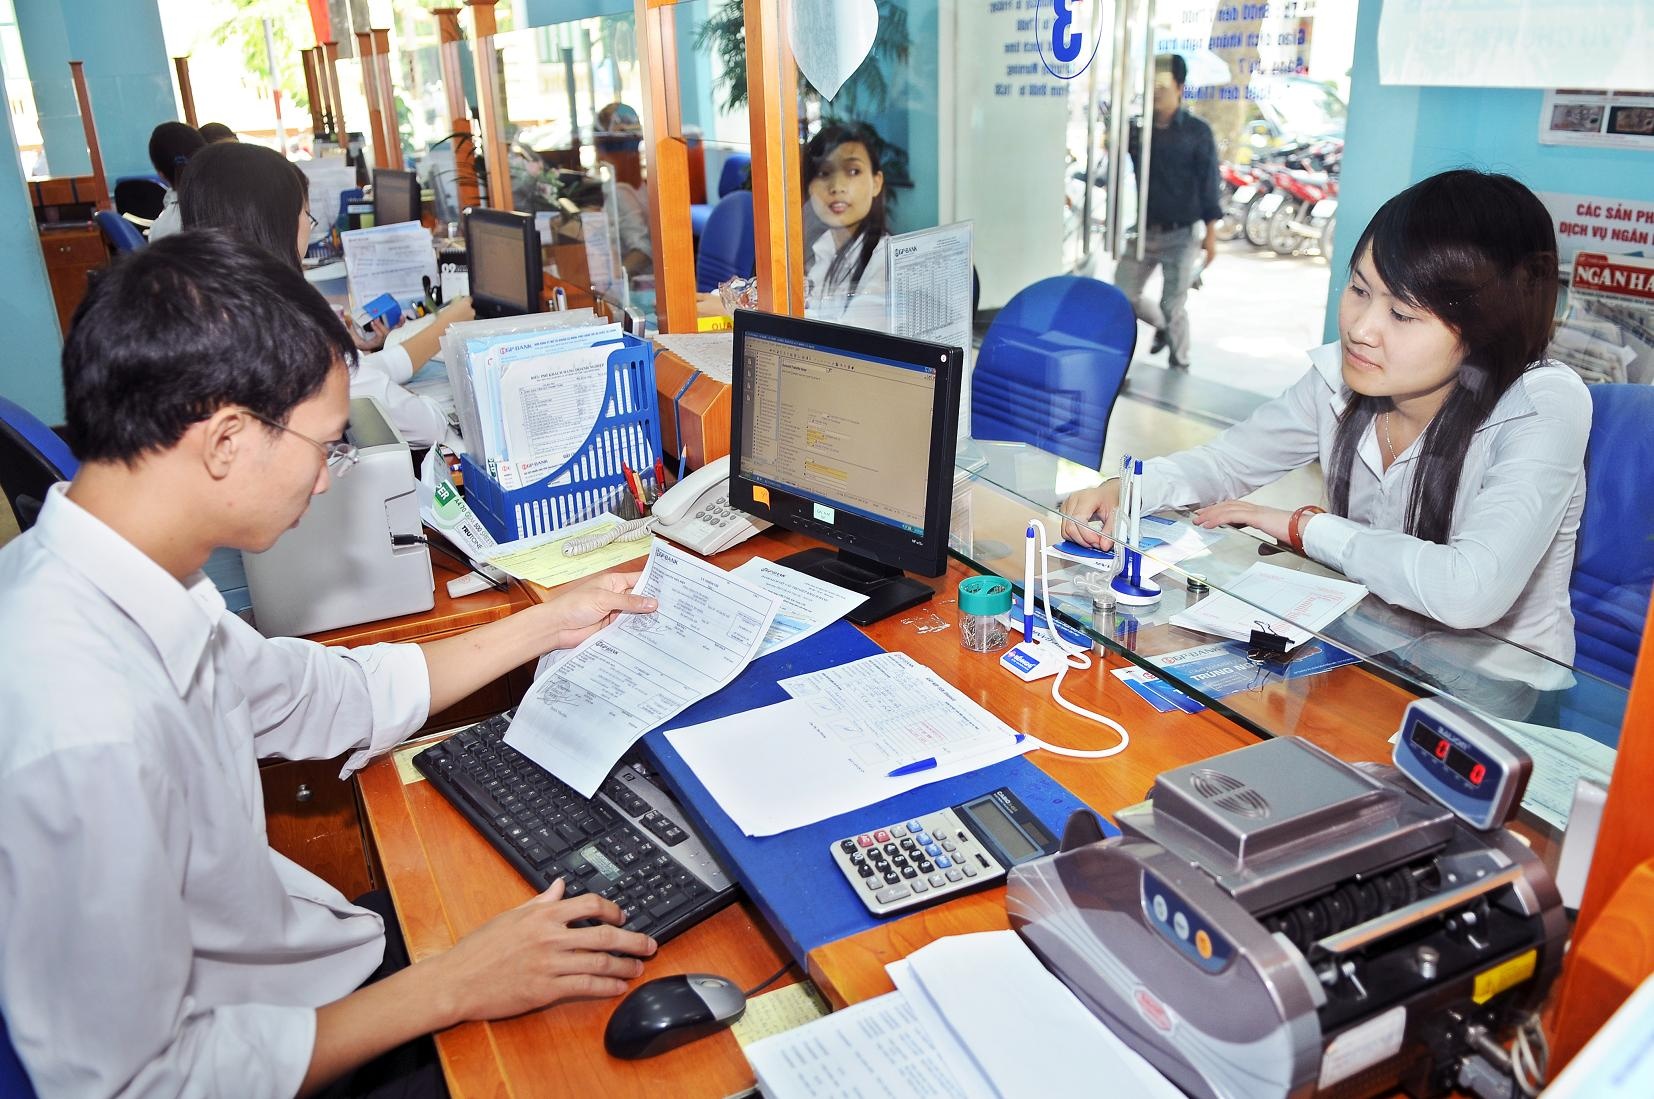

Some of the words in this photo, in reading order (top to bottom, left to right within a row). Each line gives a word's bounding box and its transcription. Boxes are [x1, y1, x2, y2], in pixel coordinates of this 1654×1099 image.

[1576, 202, 1602, 217] CÁC
[1605, 202, 1632, 222] SẢN
[1559, 222, 1588, 237] DỊCH
[1592, 225, 1608, 240] VỤ
